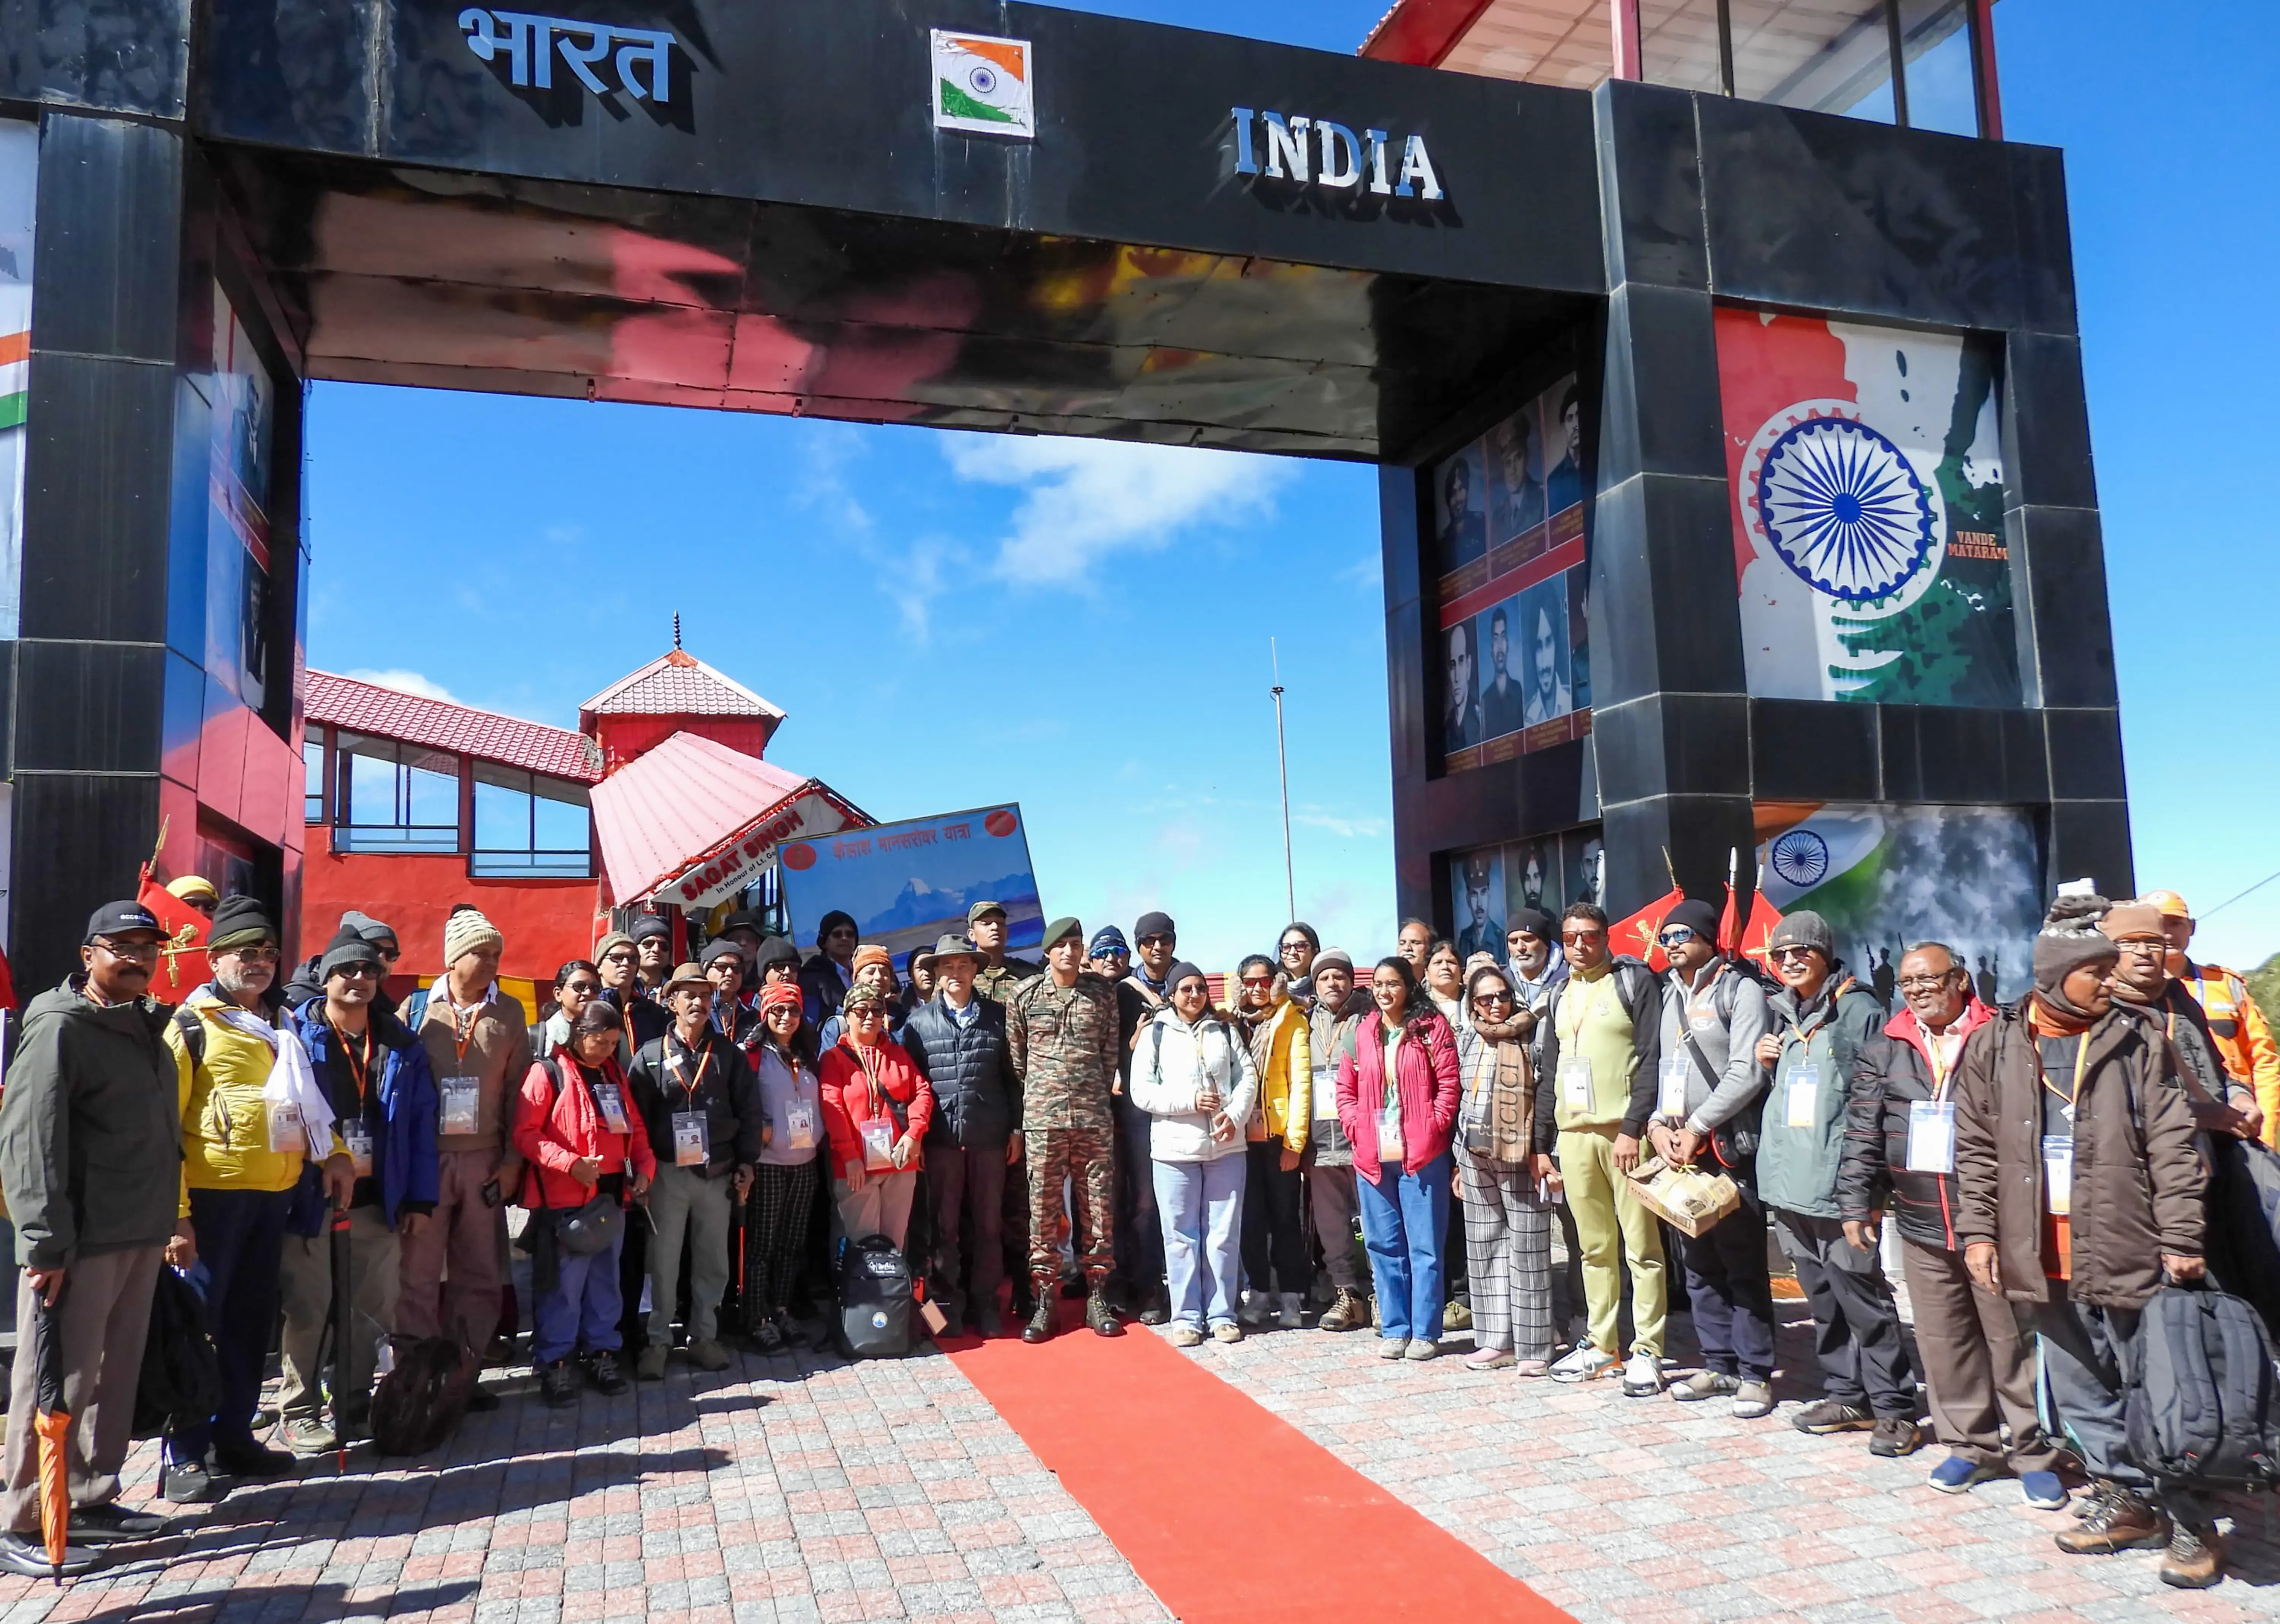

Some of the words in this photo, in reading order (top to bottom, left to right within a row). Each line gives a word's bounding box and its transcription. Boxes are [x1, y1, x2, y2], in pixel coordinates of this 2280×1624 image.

[458, 8, 677, 103] भारत
[1231, 107, 1443, 199] INDIA
[1948, 544, 2008, 559] MATARAM
[1957, 531, 1996, 546] VANDE
[943, 823, 971, 841] यात्रा
[681, 849, 743, 901] SAGAT
[743, 809, 804, 858] SINGH
[716, 886, 724, 894] In
[725, 869, 748, 888] Honour
[749, 863, 756, 872] of
[756, 856, 767, 866] Lt.
